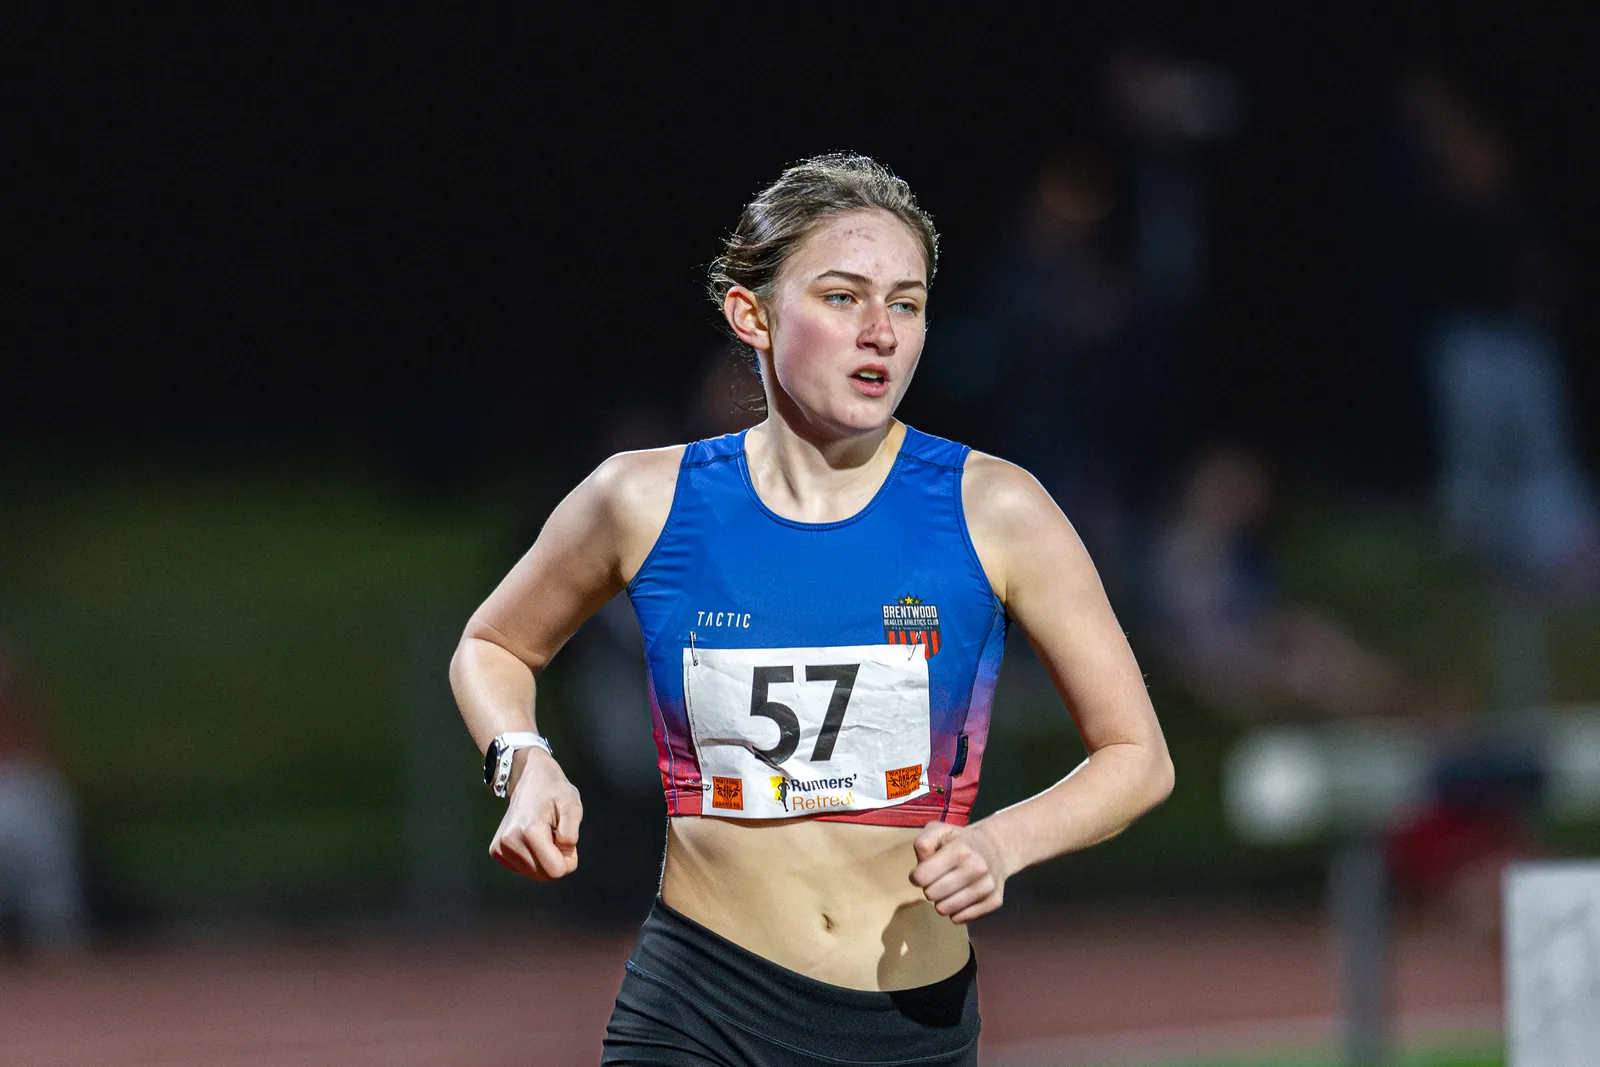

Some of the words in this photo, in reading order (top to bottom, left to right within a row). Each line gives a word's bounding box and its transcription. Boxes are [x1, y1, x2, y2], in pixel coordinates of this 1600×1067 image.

[697, 611, 751, 629] TACTIC
[883, 605, 938, 618] BRENTWOOD
[927, 618, 939, 626] CLUB
[750, 663, 861, 766] 57
[791, 791, 856, 811] Retreat
